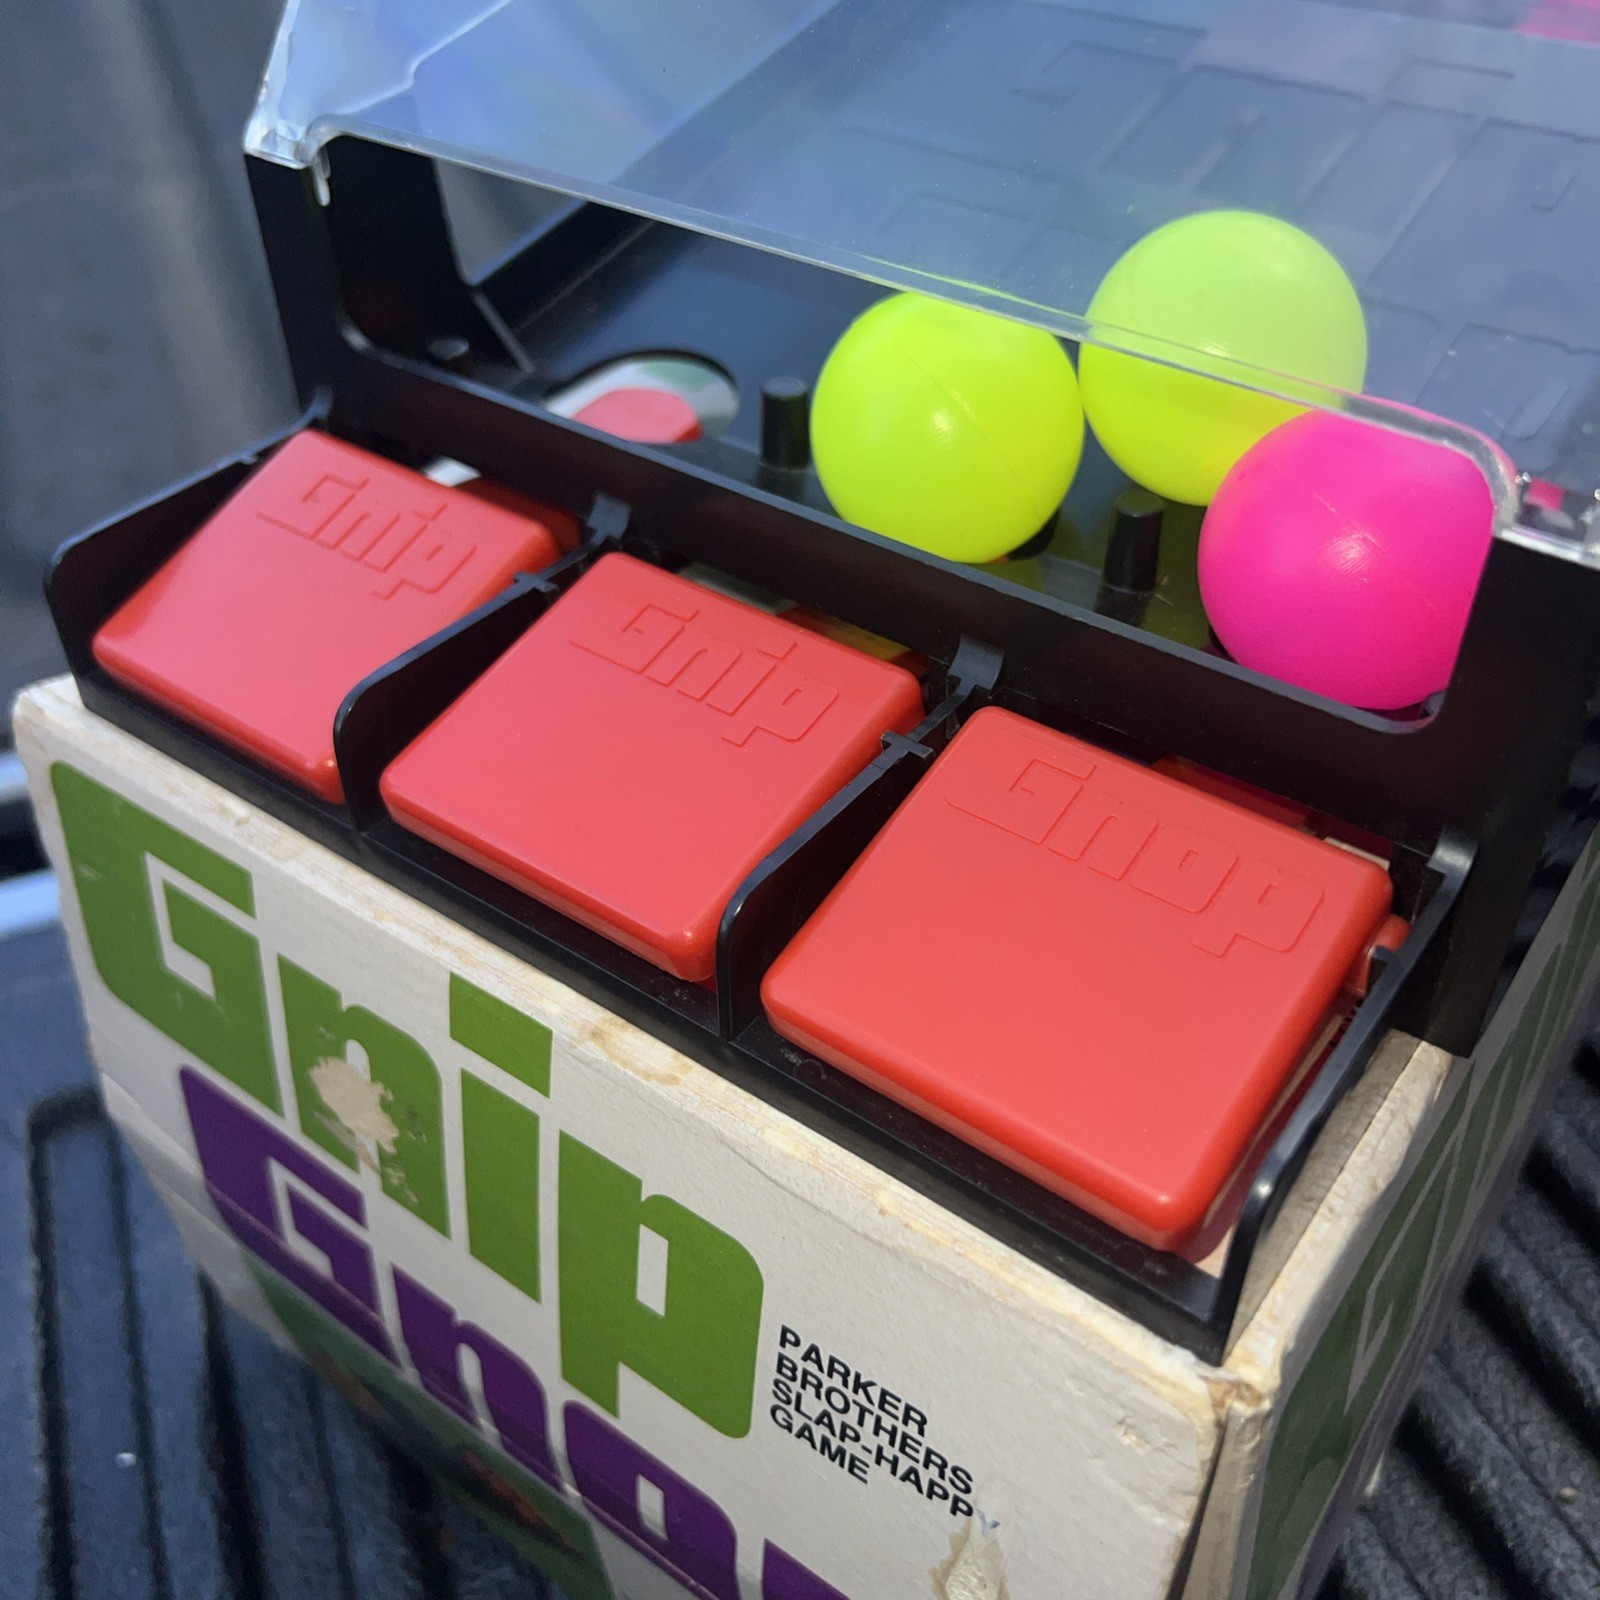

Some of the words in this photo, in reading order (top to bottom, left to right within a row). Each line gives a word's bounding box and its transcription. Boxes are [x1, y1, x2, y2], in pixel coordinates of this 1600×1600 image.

[257, 462, 478, 601] Gnip
[568, 592, 840, 748] Gnip
[944, 728, 1326, 958] Gnop
[50, 761, 765, 1439] Gnip
[179, 1065, 853, 1600] Gno
[779, 1324, 928, 1438] PARKER
[770, 1404, 870, 1485] GAME
[775, 1352, 974, 1495] BROTHERS
